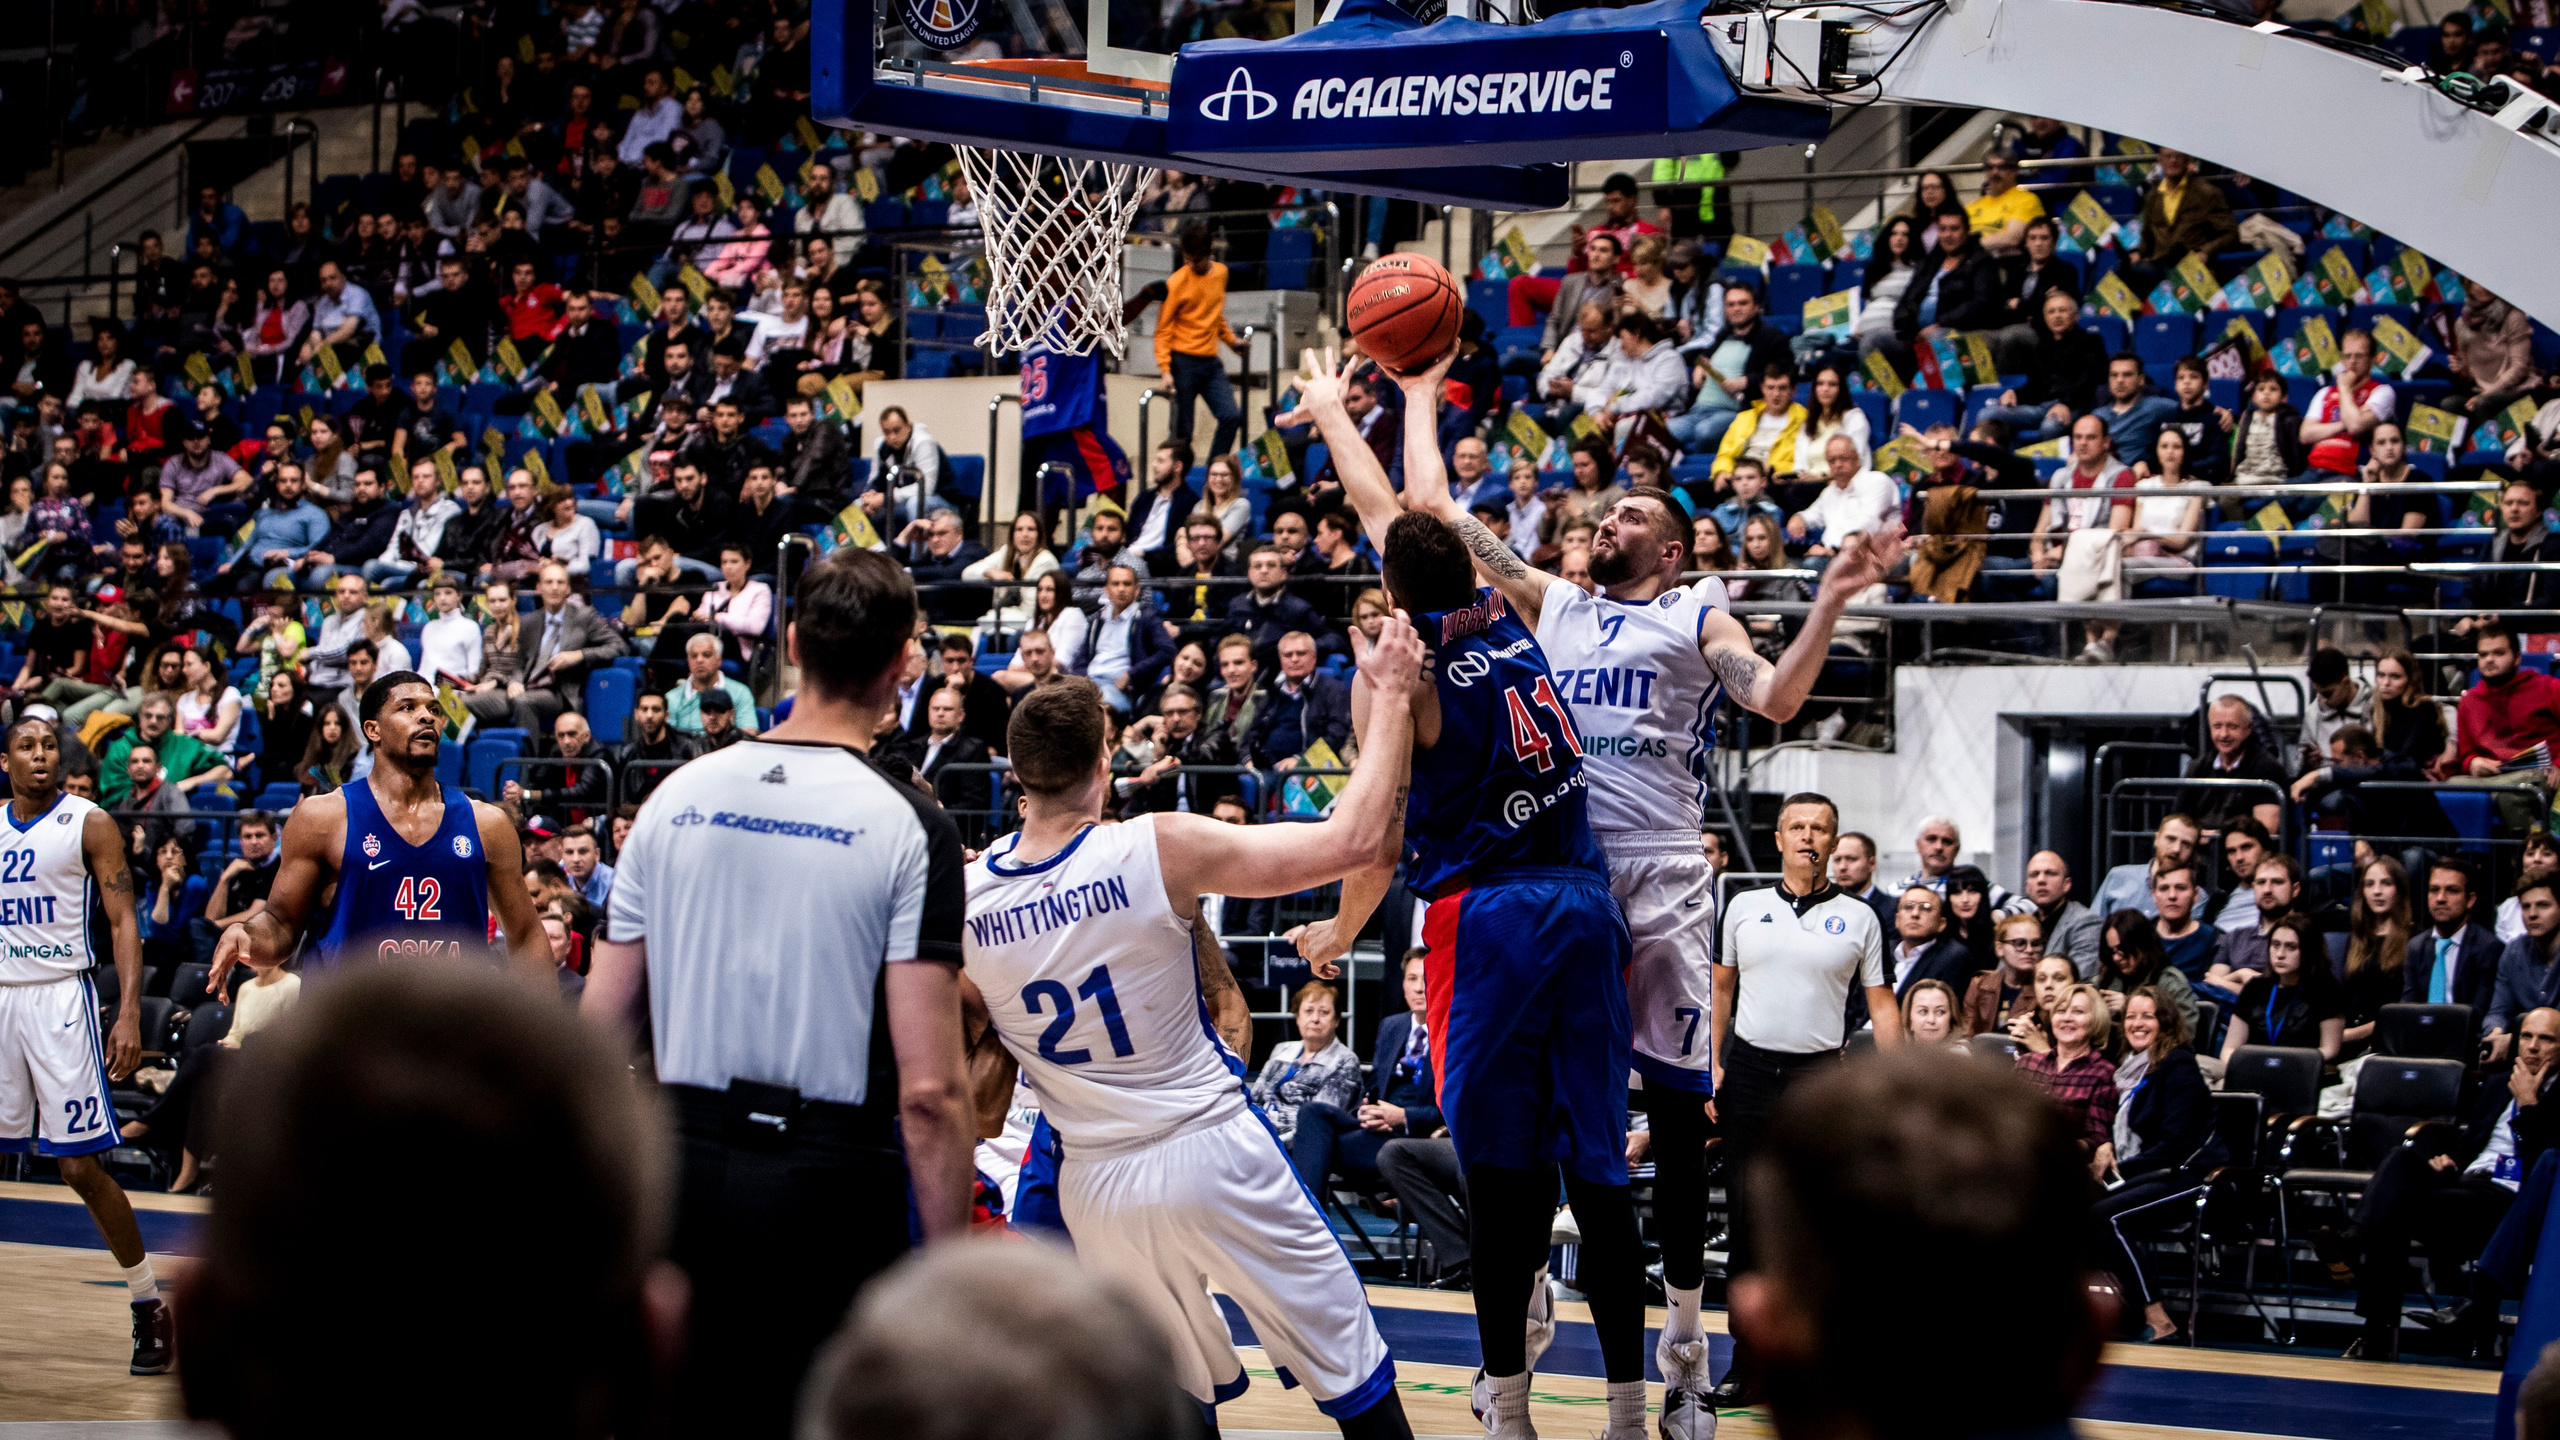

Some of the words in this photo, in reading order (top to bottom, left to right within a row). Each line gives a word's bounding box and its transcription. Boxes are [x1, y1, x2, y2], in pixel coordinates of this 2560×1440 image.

[905, 9, 920, 30] VTB
[918, 27, 950, 46] UNITED
[950, 17, 980, 44] LEAGUE
[1599, 615, 1626, 647] 7
[1556, 667, 1658, 710] ZENIT
[1504, 674, 1584, 774] 41
[2, 848, 36, 883] 22
[394, 876, 441, 920] 42
[966, 875, 1130, 947] WHITTINGTON
[9, 944, 73, 958] NIPIGAS
[1021, 964, 1135, 1065] 21
[1675, 1007, 1701, 1056] 7
[65, 1096, 102, 1134] 22
